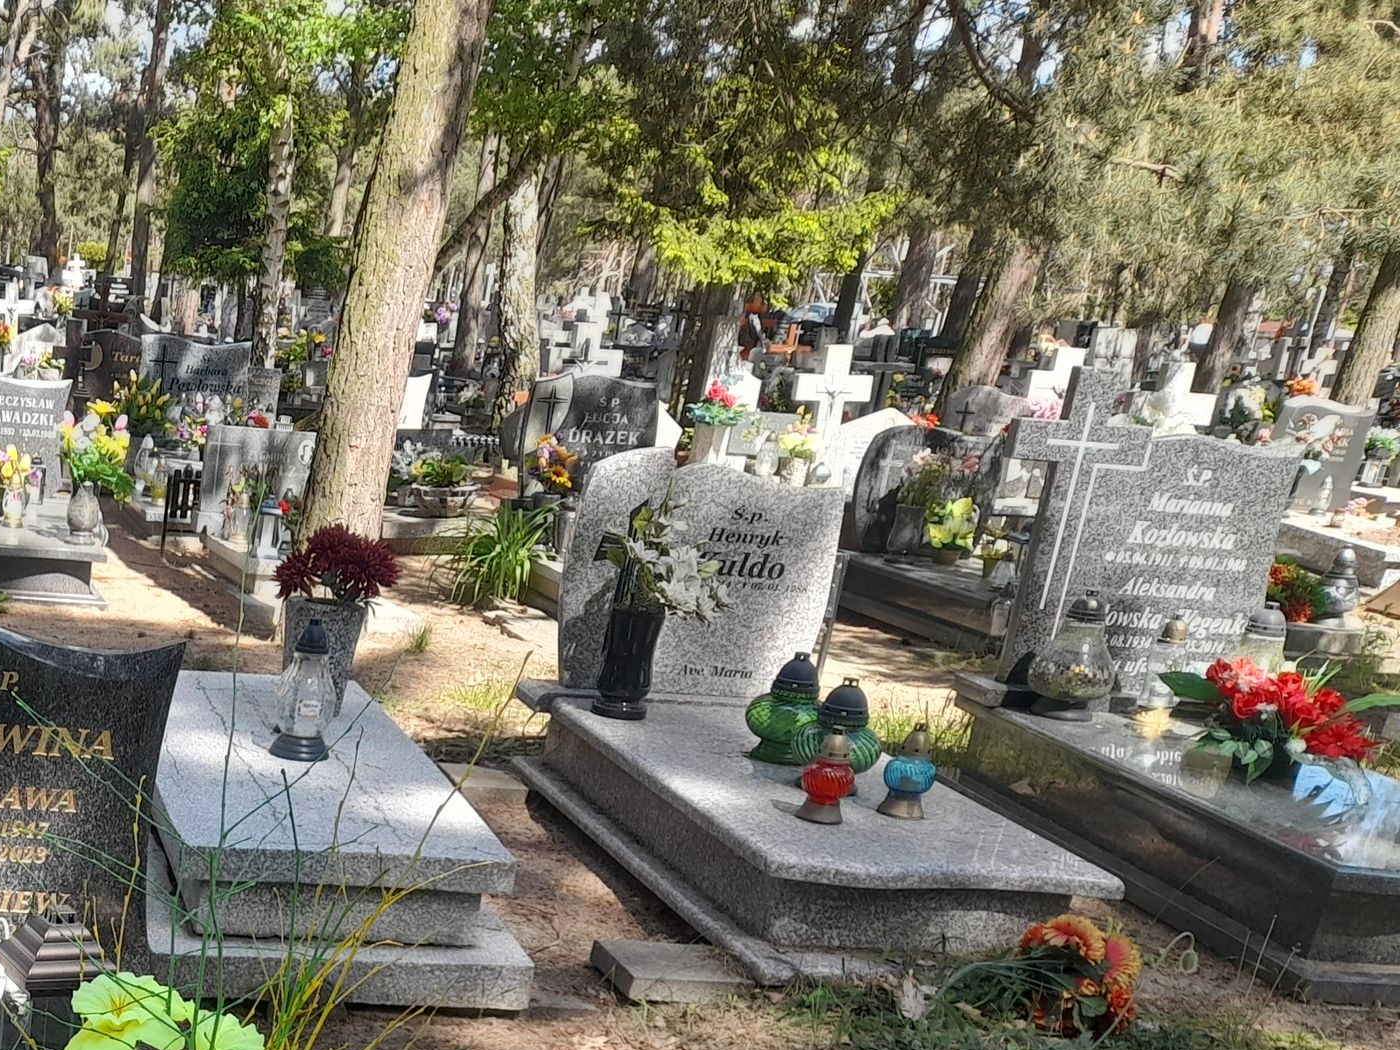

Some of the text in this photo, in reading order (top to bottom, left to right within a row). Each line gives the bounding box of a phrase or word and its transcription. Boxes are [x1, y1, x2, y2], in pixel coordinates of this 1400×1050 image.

[1147, 492, 1235, 517] Marianna
[707, 527, 785, 550] Henryk
[1126, 520, 1238, 550] Kozłowska
[1118, 576, 1217, 601] Aleksandra
[678, 664, 754, 679] Ave Maria
